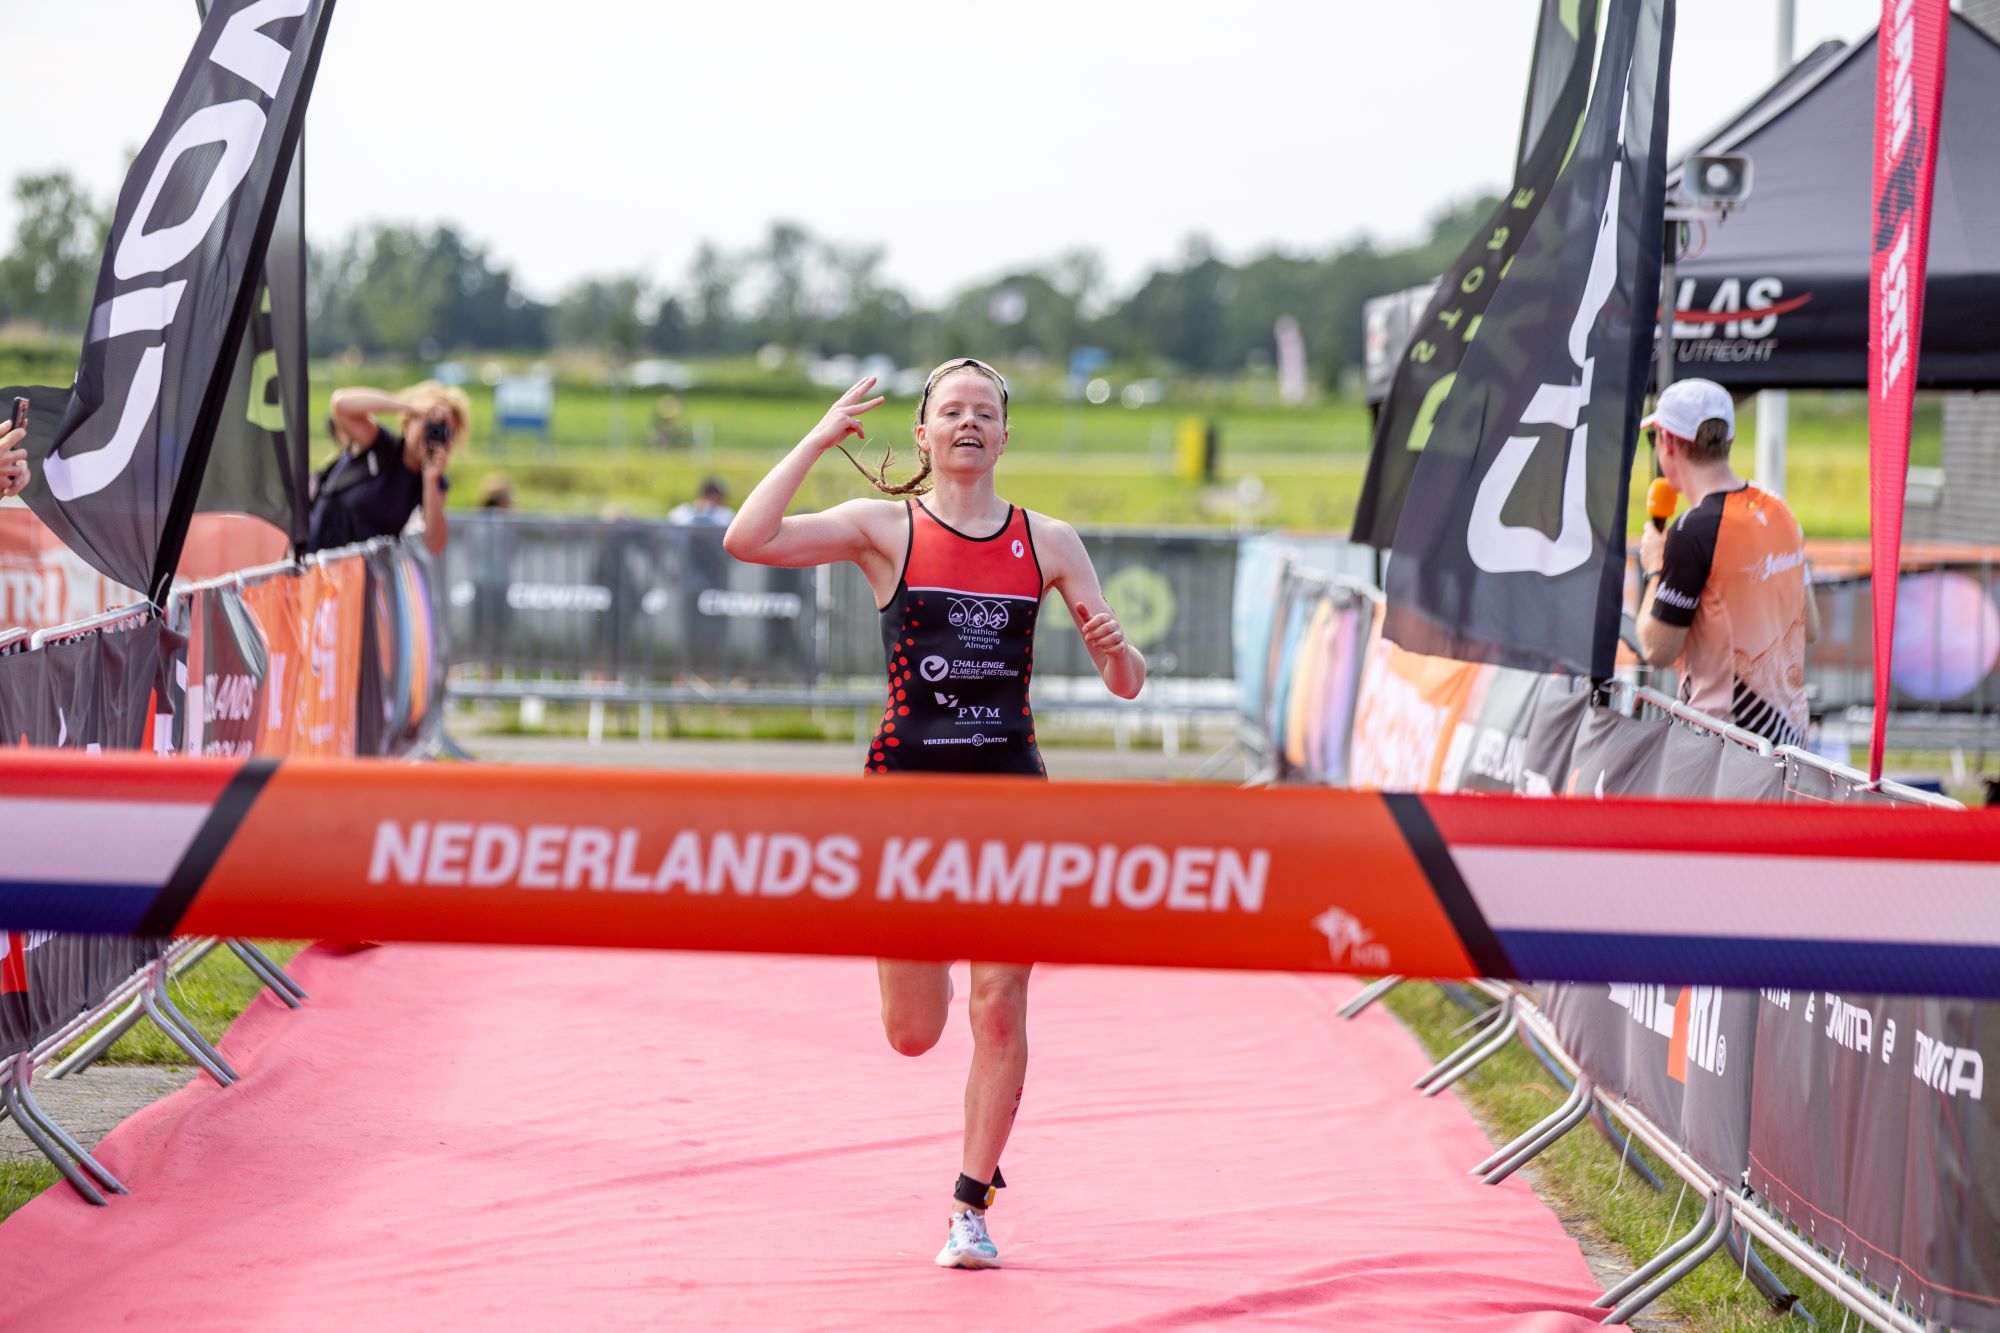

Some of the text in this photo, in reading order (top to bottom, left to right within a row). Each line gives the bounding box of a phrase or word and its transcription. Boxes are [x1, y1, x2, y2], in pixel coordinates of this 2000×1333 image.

[1677, 338, 1779, 362] UTRECHT
[962, 626, 998, 636] Triathlon
[957, 634, 1000, 645] Vereniging
[964, 641, 993, 650] Almere
[952, 659, 1006, 670] CHALLENGE
[950, 667, 1019, 677] ALMERE-AMSTERDAM
[957, 706, 1001, 719] PVM
[923, 737, 972, 745] VERZEKERING
[367, 819, 1271, 914] NEDERLANDS KAMPIOEN
